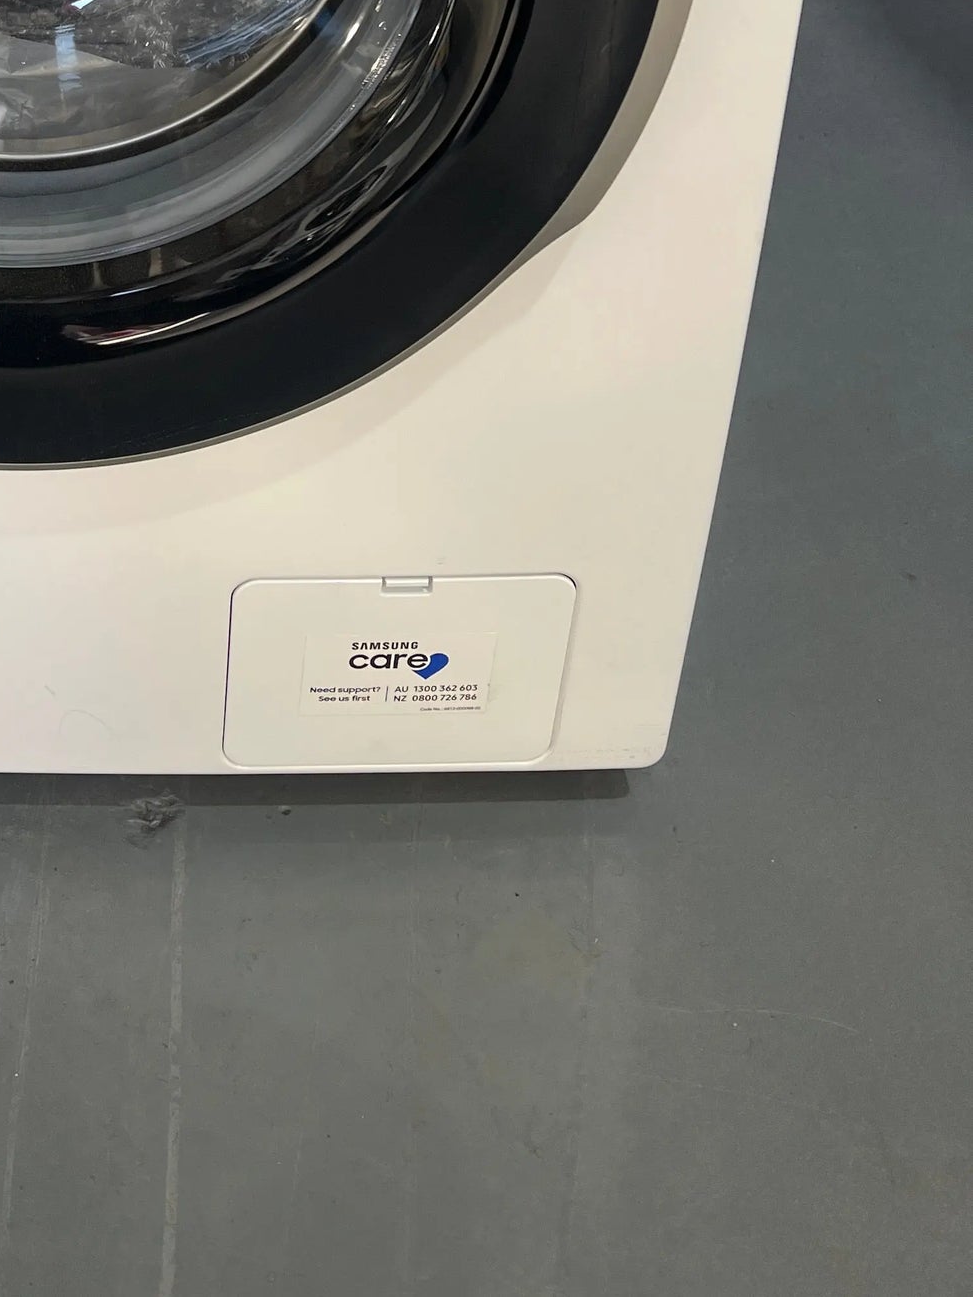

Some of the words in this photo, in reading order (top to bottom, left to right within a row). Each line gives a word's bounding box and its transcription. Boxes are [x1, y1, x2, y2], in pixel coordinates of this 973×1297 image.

[351, 641, 419, 651] SAMSUNG
[349, 653, 429, 670] care
[338, 686, 381, 694] support?
[394, 685, 409, 693] AU
[414, 685, 438, 693] 1300
[439, 684, 458, 692] 362
[459, 684, 478, 692] 603
[412, 694, 438, 702] 0800
[459, 693, 477, 701] 786
